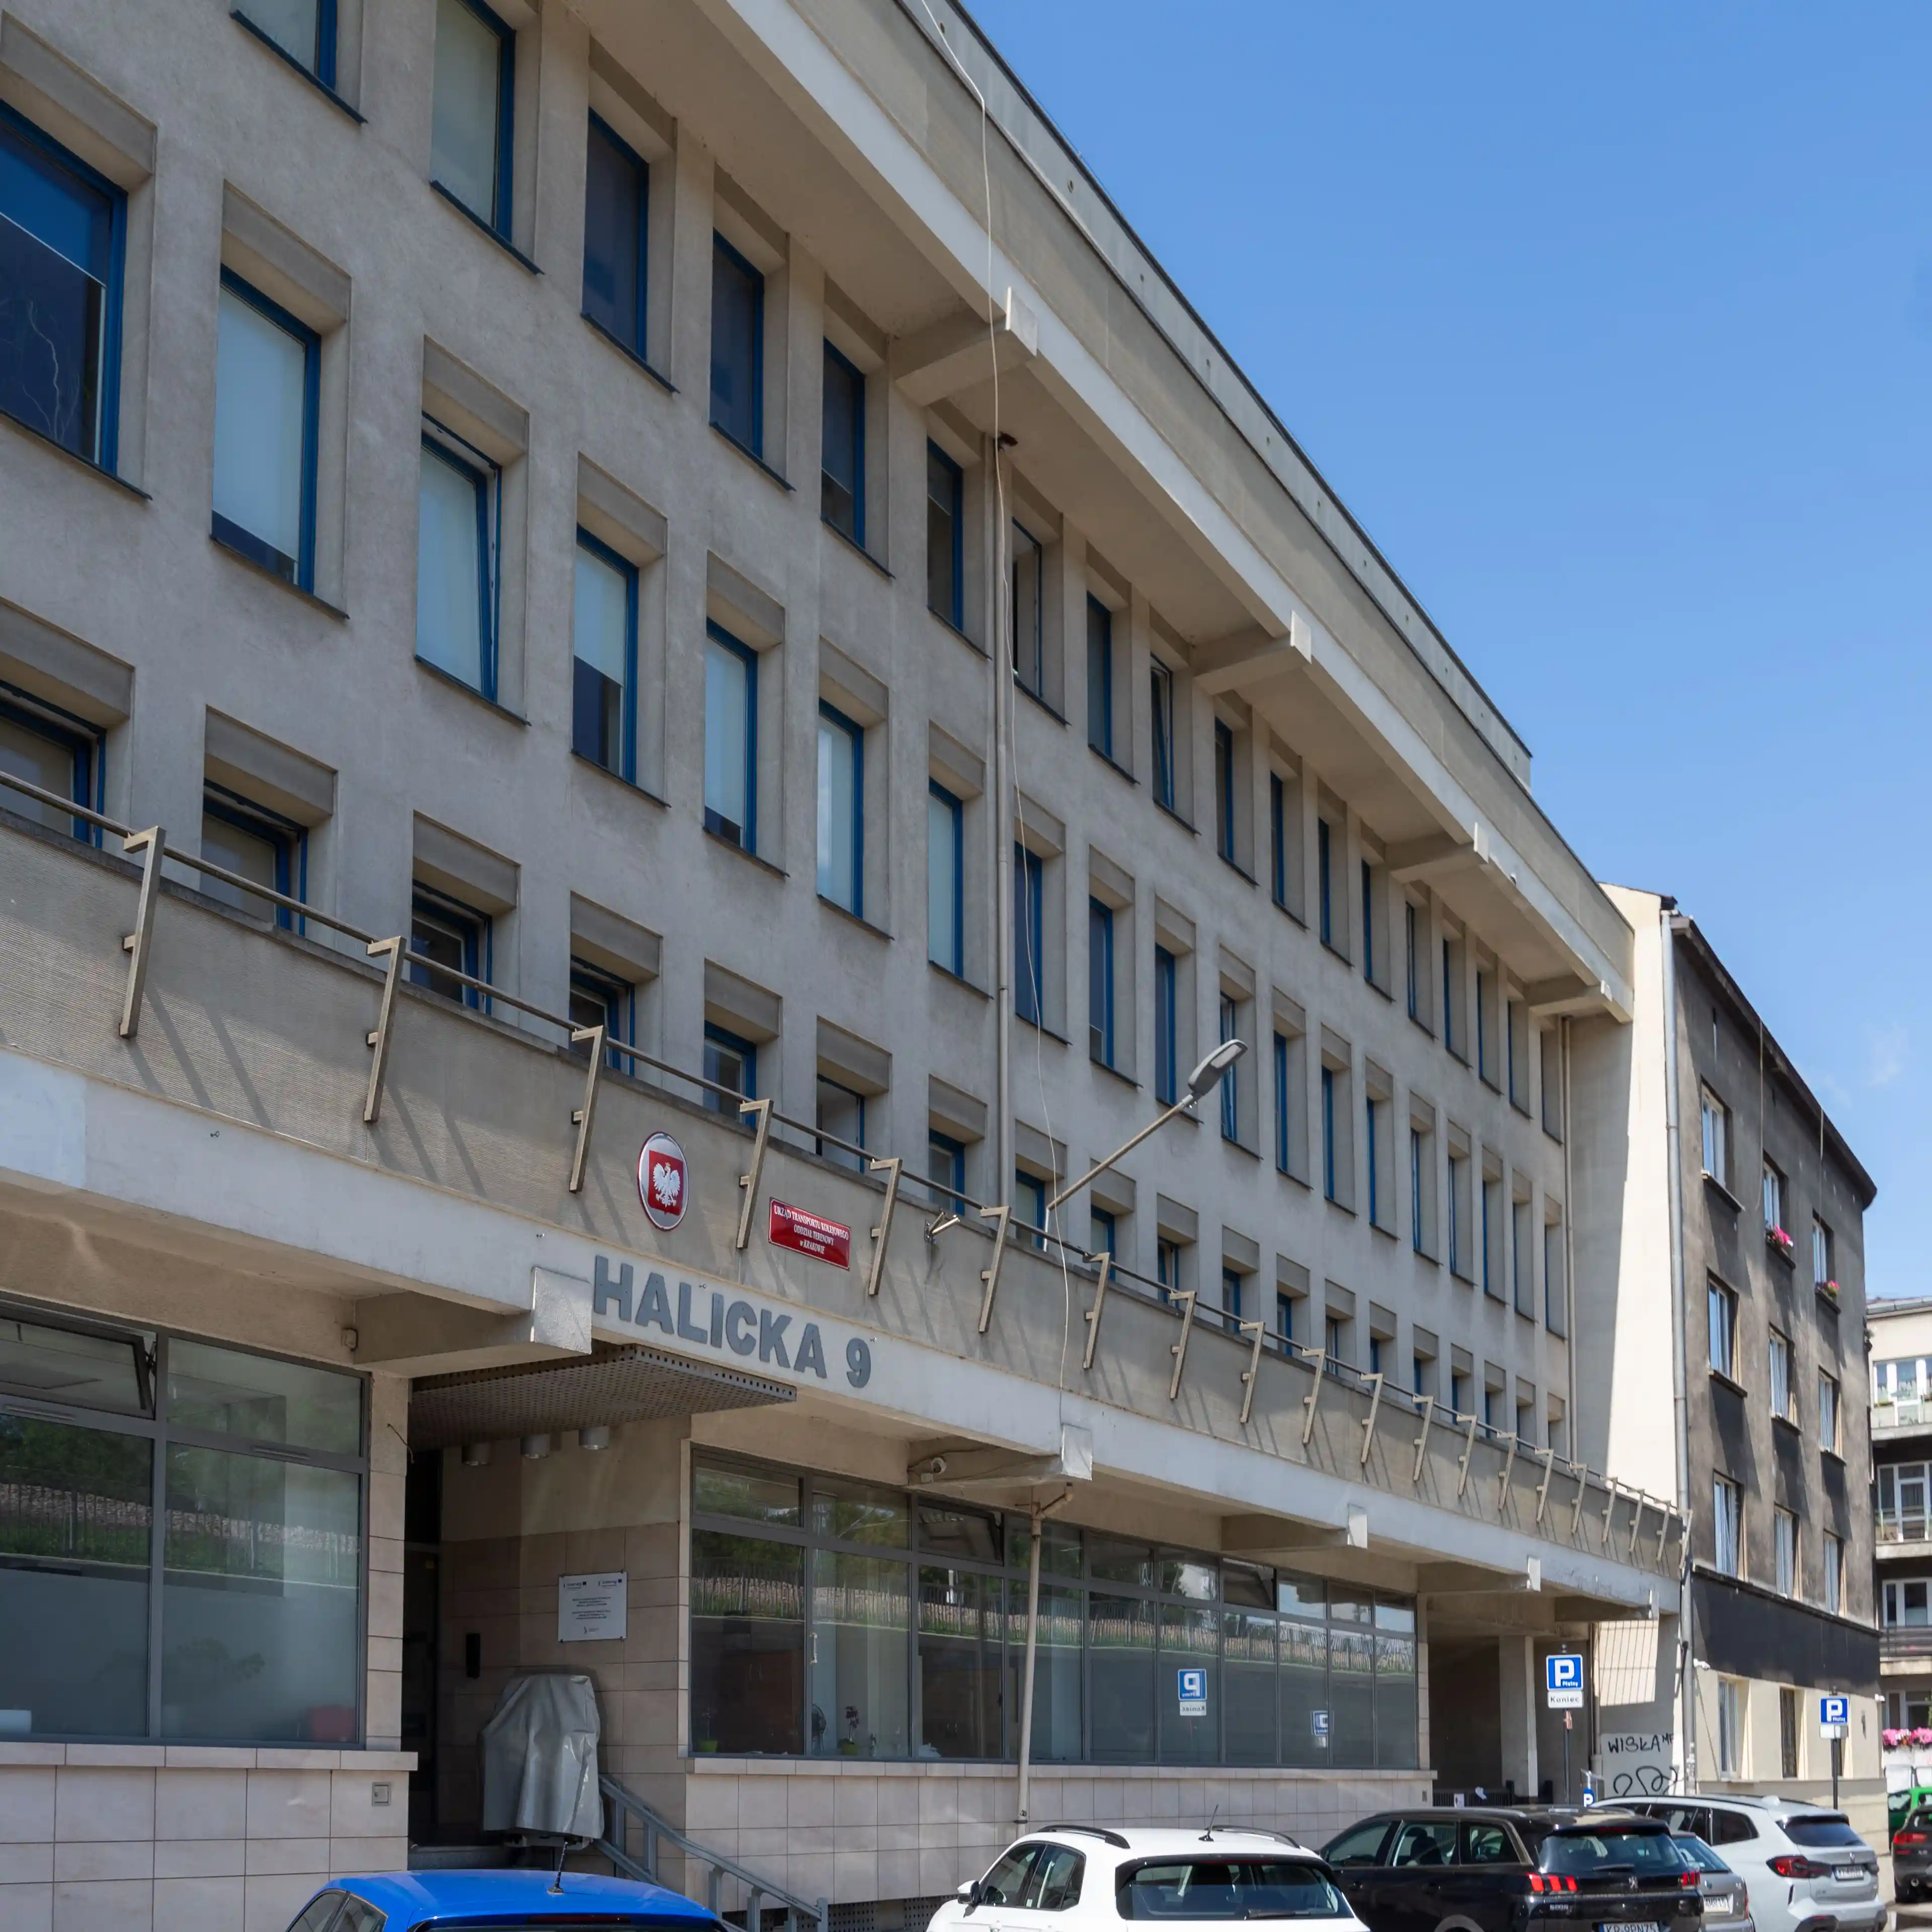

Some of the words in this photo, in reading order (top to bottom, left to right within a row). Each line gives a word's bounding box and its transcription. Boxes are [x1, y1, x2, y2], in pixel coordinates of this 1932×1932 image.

[774, 1205, 791, 1220] URZĄD
[791, 1212, 821, 1229] TRANSPORTU
[821, 1222, 849, 1240] KOLEJOWEGO
[793, 1224, 813, 1238] ODDZIAŁ
[813, 1231, 834, 1246] TERENOWY
[803, 1240, 825, 1254] KRAKOWIE
[594, 1255, 827, 1379] HALICKA
[846, 1337, 871, 1388] 9
[1554, 1659, 1575, 1687] P
[1826, 1700, 1843, 1722] P
